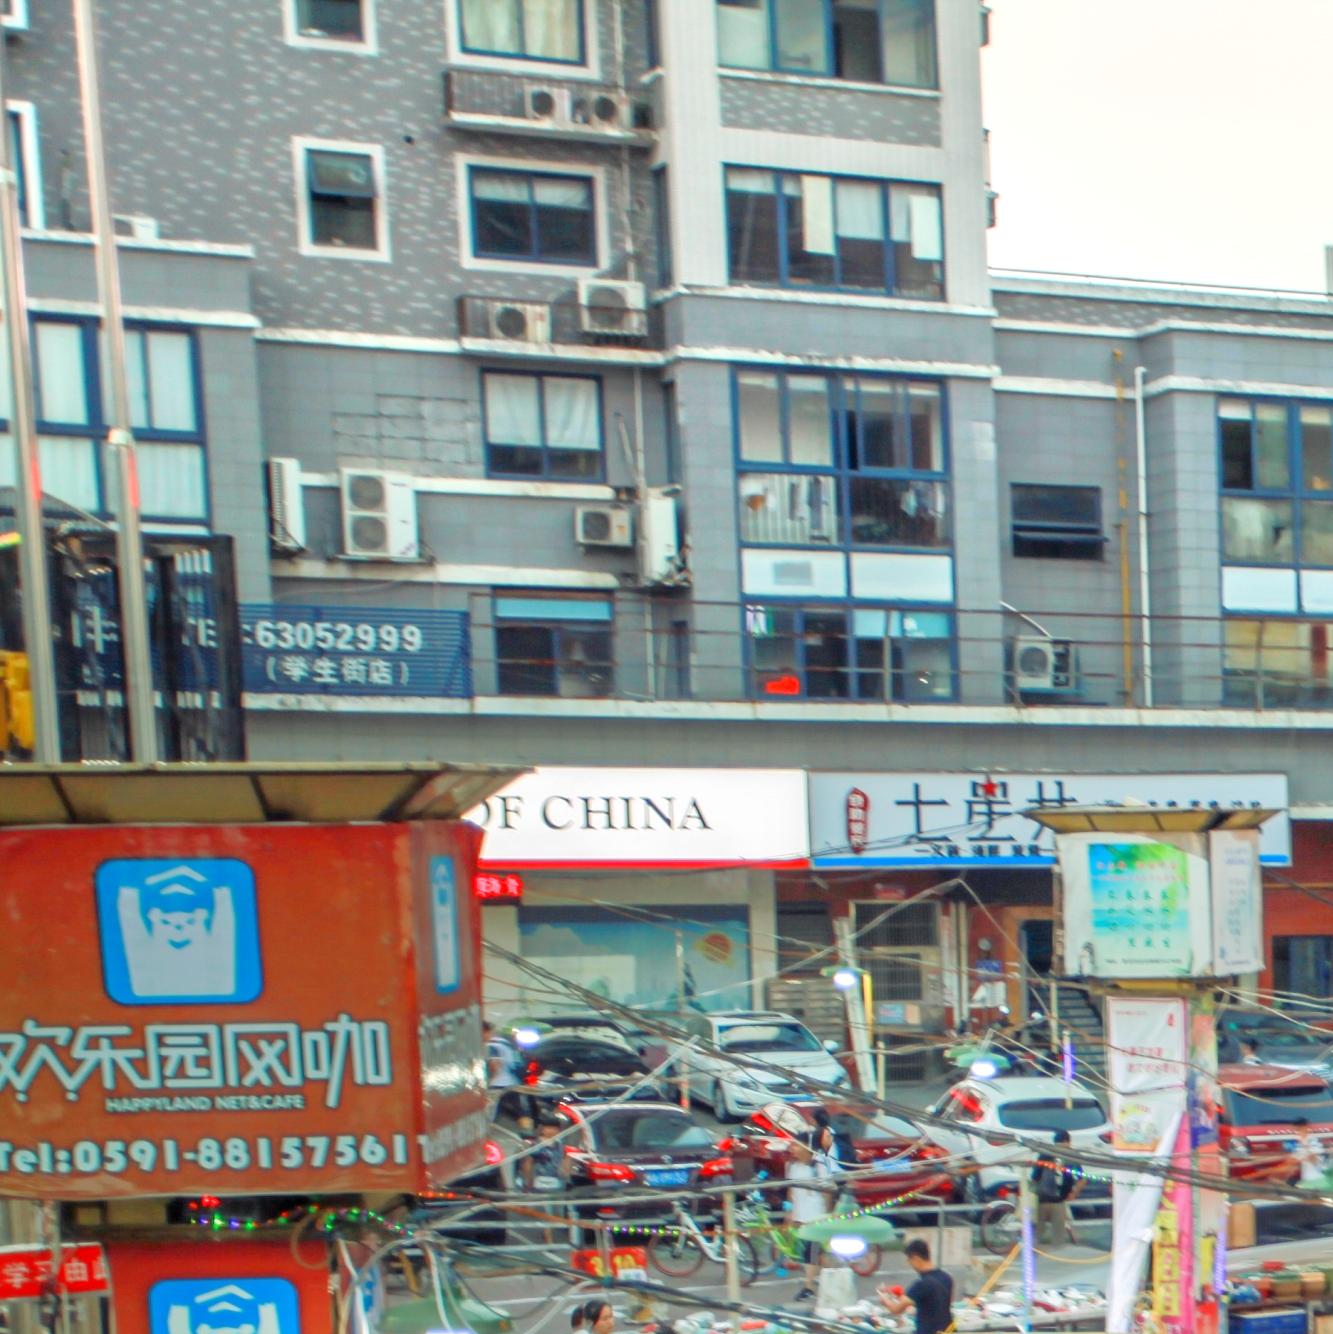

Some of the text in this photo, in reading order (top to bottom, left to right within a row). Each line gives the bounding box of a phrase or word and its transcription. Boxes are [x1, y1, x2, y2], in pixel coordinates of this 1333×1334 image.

[540, 794, 713, 830] CHINA
[0, 1014, 392, 1108] 欢乐园网咖
[106, 1096, 212, 1113] HAPPYLAND
